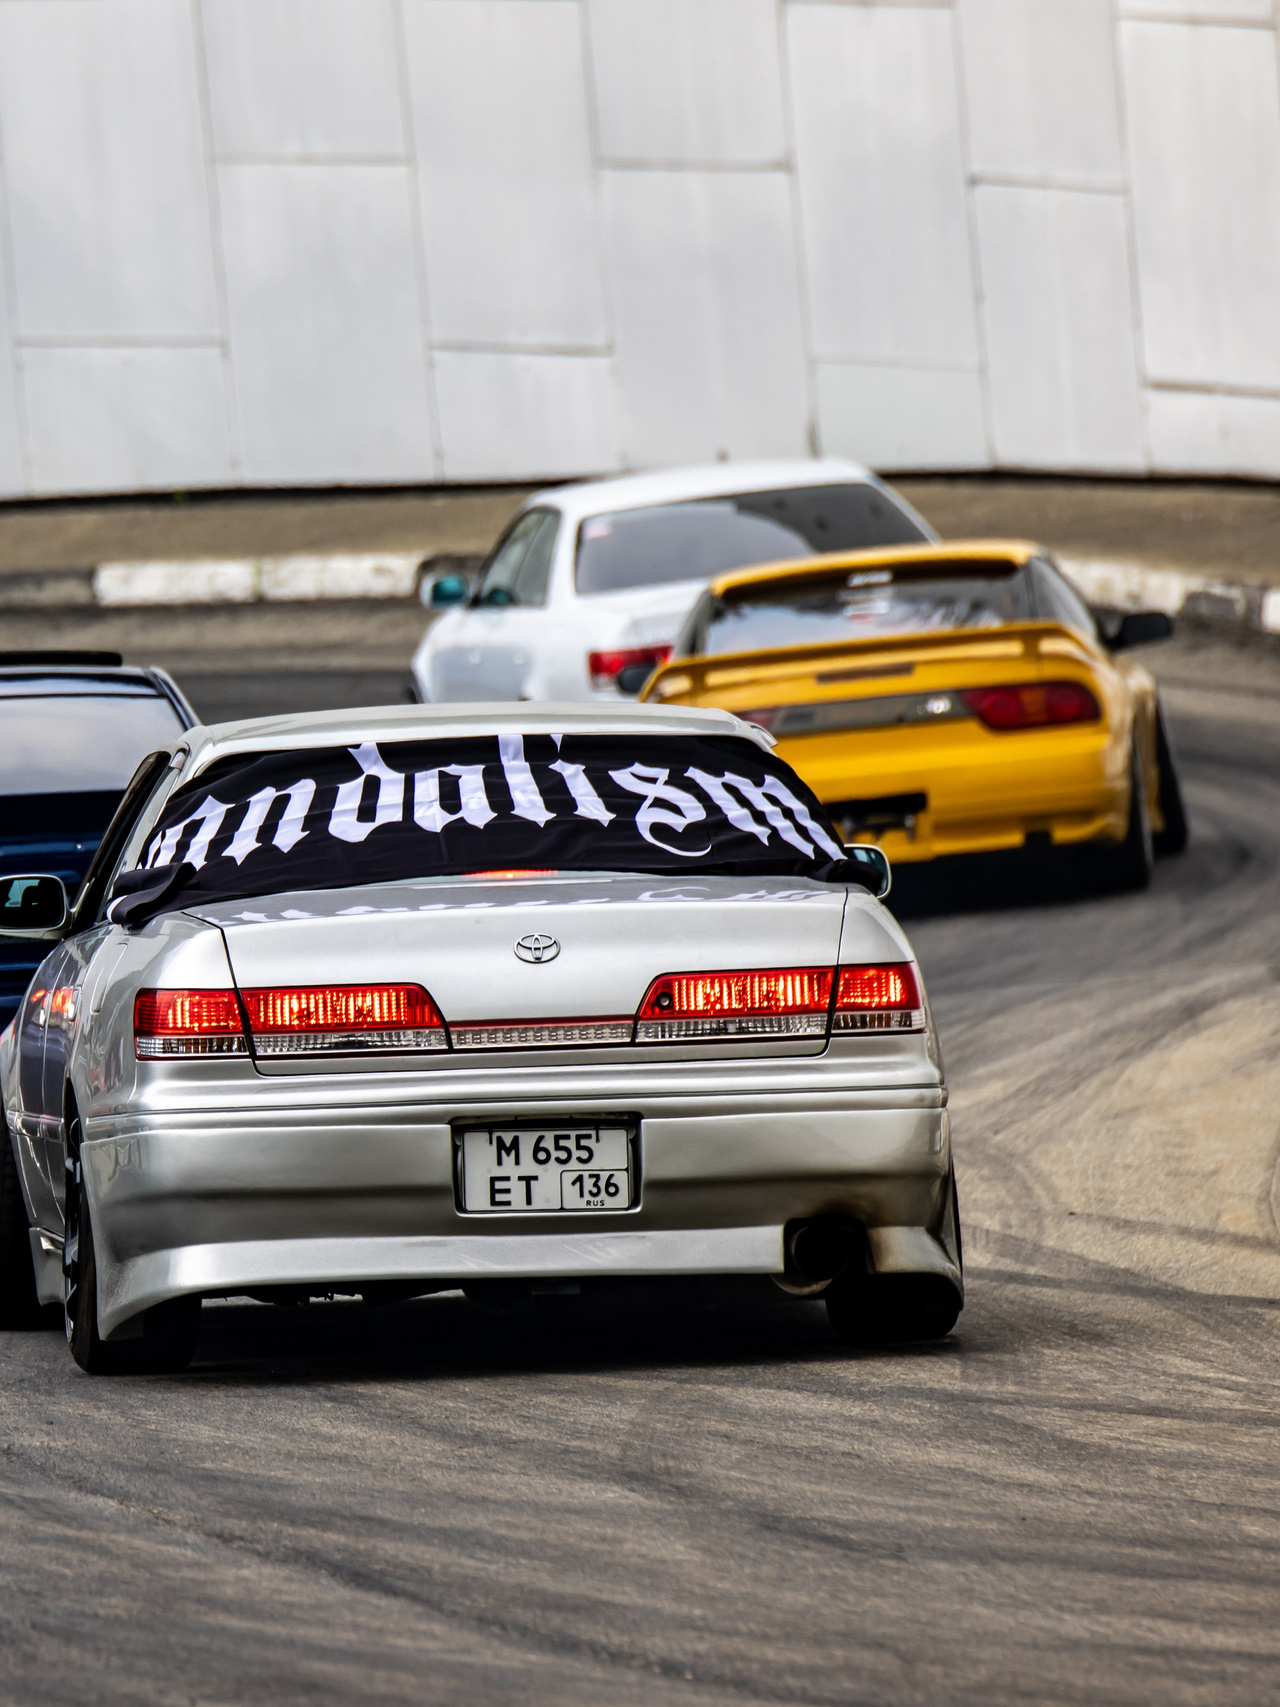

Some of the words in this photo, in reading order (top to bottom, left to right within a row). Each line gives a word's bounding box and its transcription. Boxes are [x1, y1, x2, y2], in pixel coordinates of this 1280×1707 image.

[136, 734, 848, 870] andalism
[496, 1134, 520, 1166] M
[532, 1133, 594, 1166] 655
[489, 1175, 539, 1206] ET
[571, 1173, 620, 1198] 136
[585, 1199, 606, 1207] RUS
